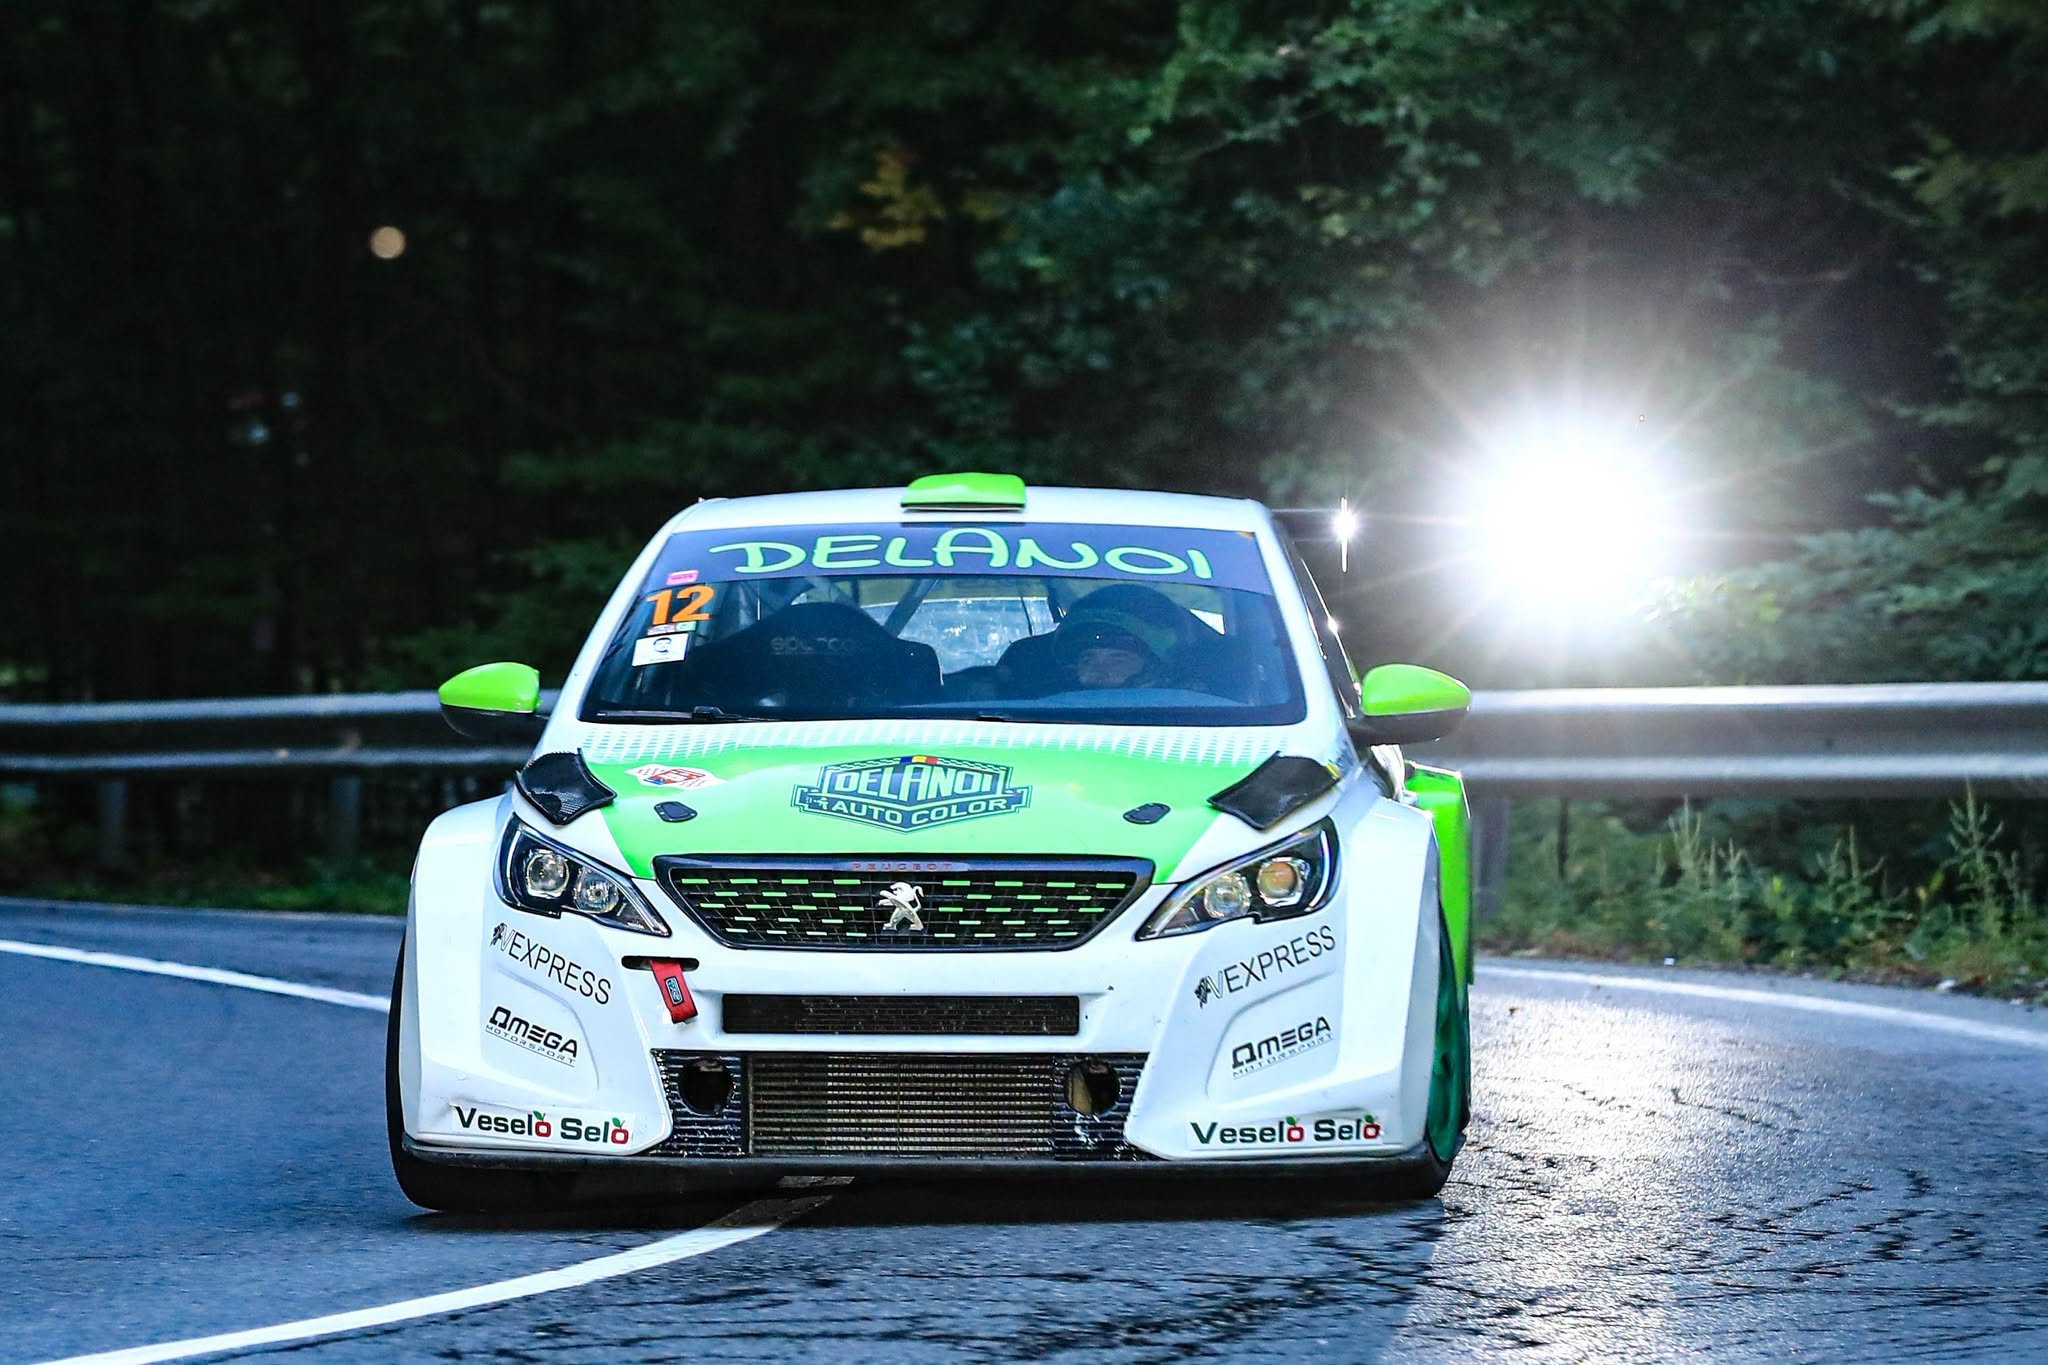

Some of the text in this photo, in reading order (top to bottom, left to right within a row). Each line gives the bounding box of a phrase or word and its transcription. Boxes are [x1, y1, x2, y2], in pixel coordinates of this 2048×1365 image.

[709, 527, 1213, 578] DELANOI
[646, 584, 715, 625] 12
[833, 764, 995, 801] DELANOI
[832, 798, 1007, 825] AUTO COLOR
[852, 862, 952, 871] PEUGEOT
[486, 1025, 576, 1064] MOTORSPORT
[454, 1106, 630, 1145] Veselo Selo
[1190, 1115, 1382, 1144] Veselo Selo
